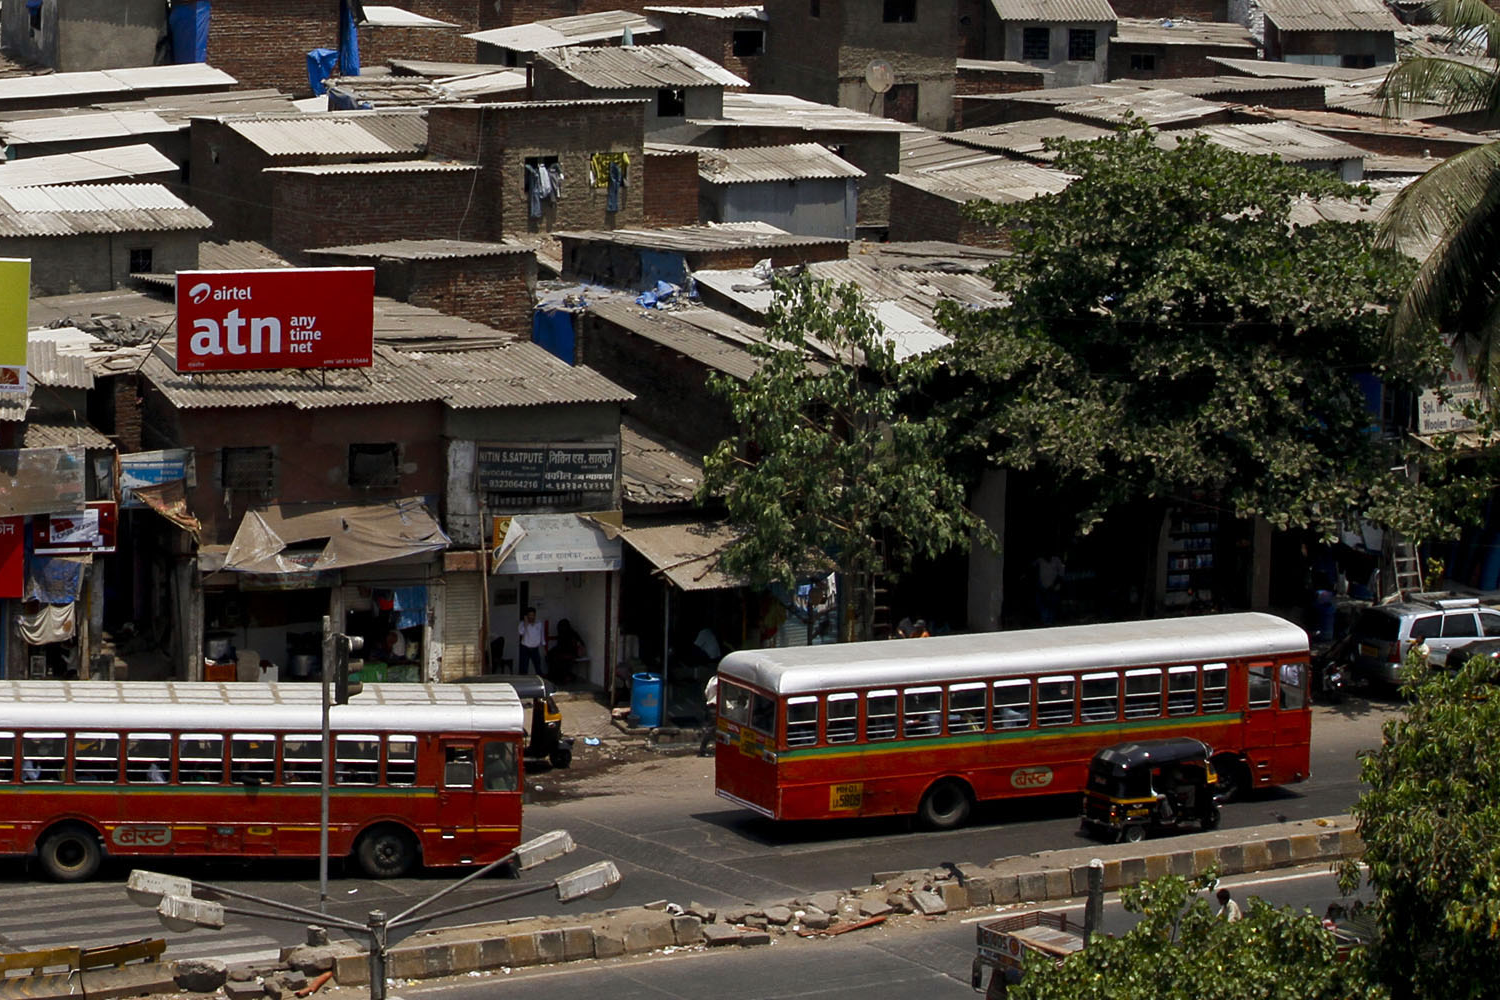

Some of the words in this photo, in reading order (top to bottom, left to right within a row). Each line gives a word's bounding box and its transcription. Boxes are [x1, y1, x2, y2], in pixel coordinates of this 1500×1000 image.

[213, 286, 252, 300] airtel
[290, 316, 316, 329] any
[190, 308, 281, 356] atn
[290, 328, 322, 341] time
[290, 342, 313, 353] net
[1423, 419, 1448, 431] Woolen
[479, 452, 500, 462] NITIN
[502, 451, 543, 463] S.SATPUTE
[548, 450, 571, 464] नितिन
[544, 470, 572, 480] वकील
[1015, 770, 1047, 785] बेस्ट
[119, 828, 168, 843] बेस्ट
